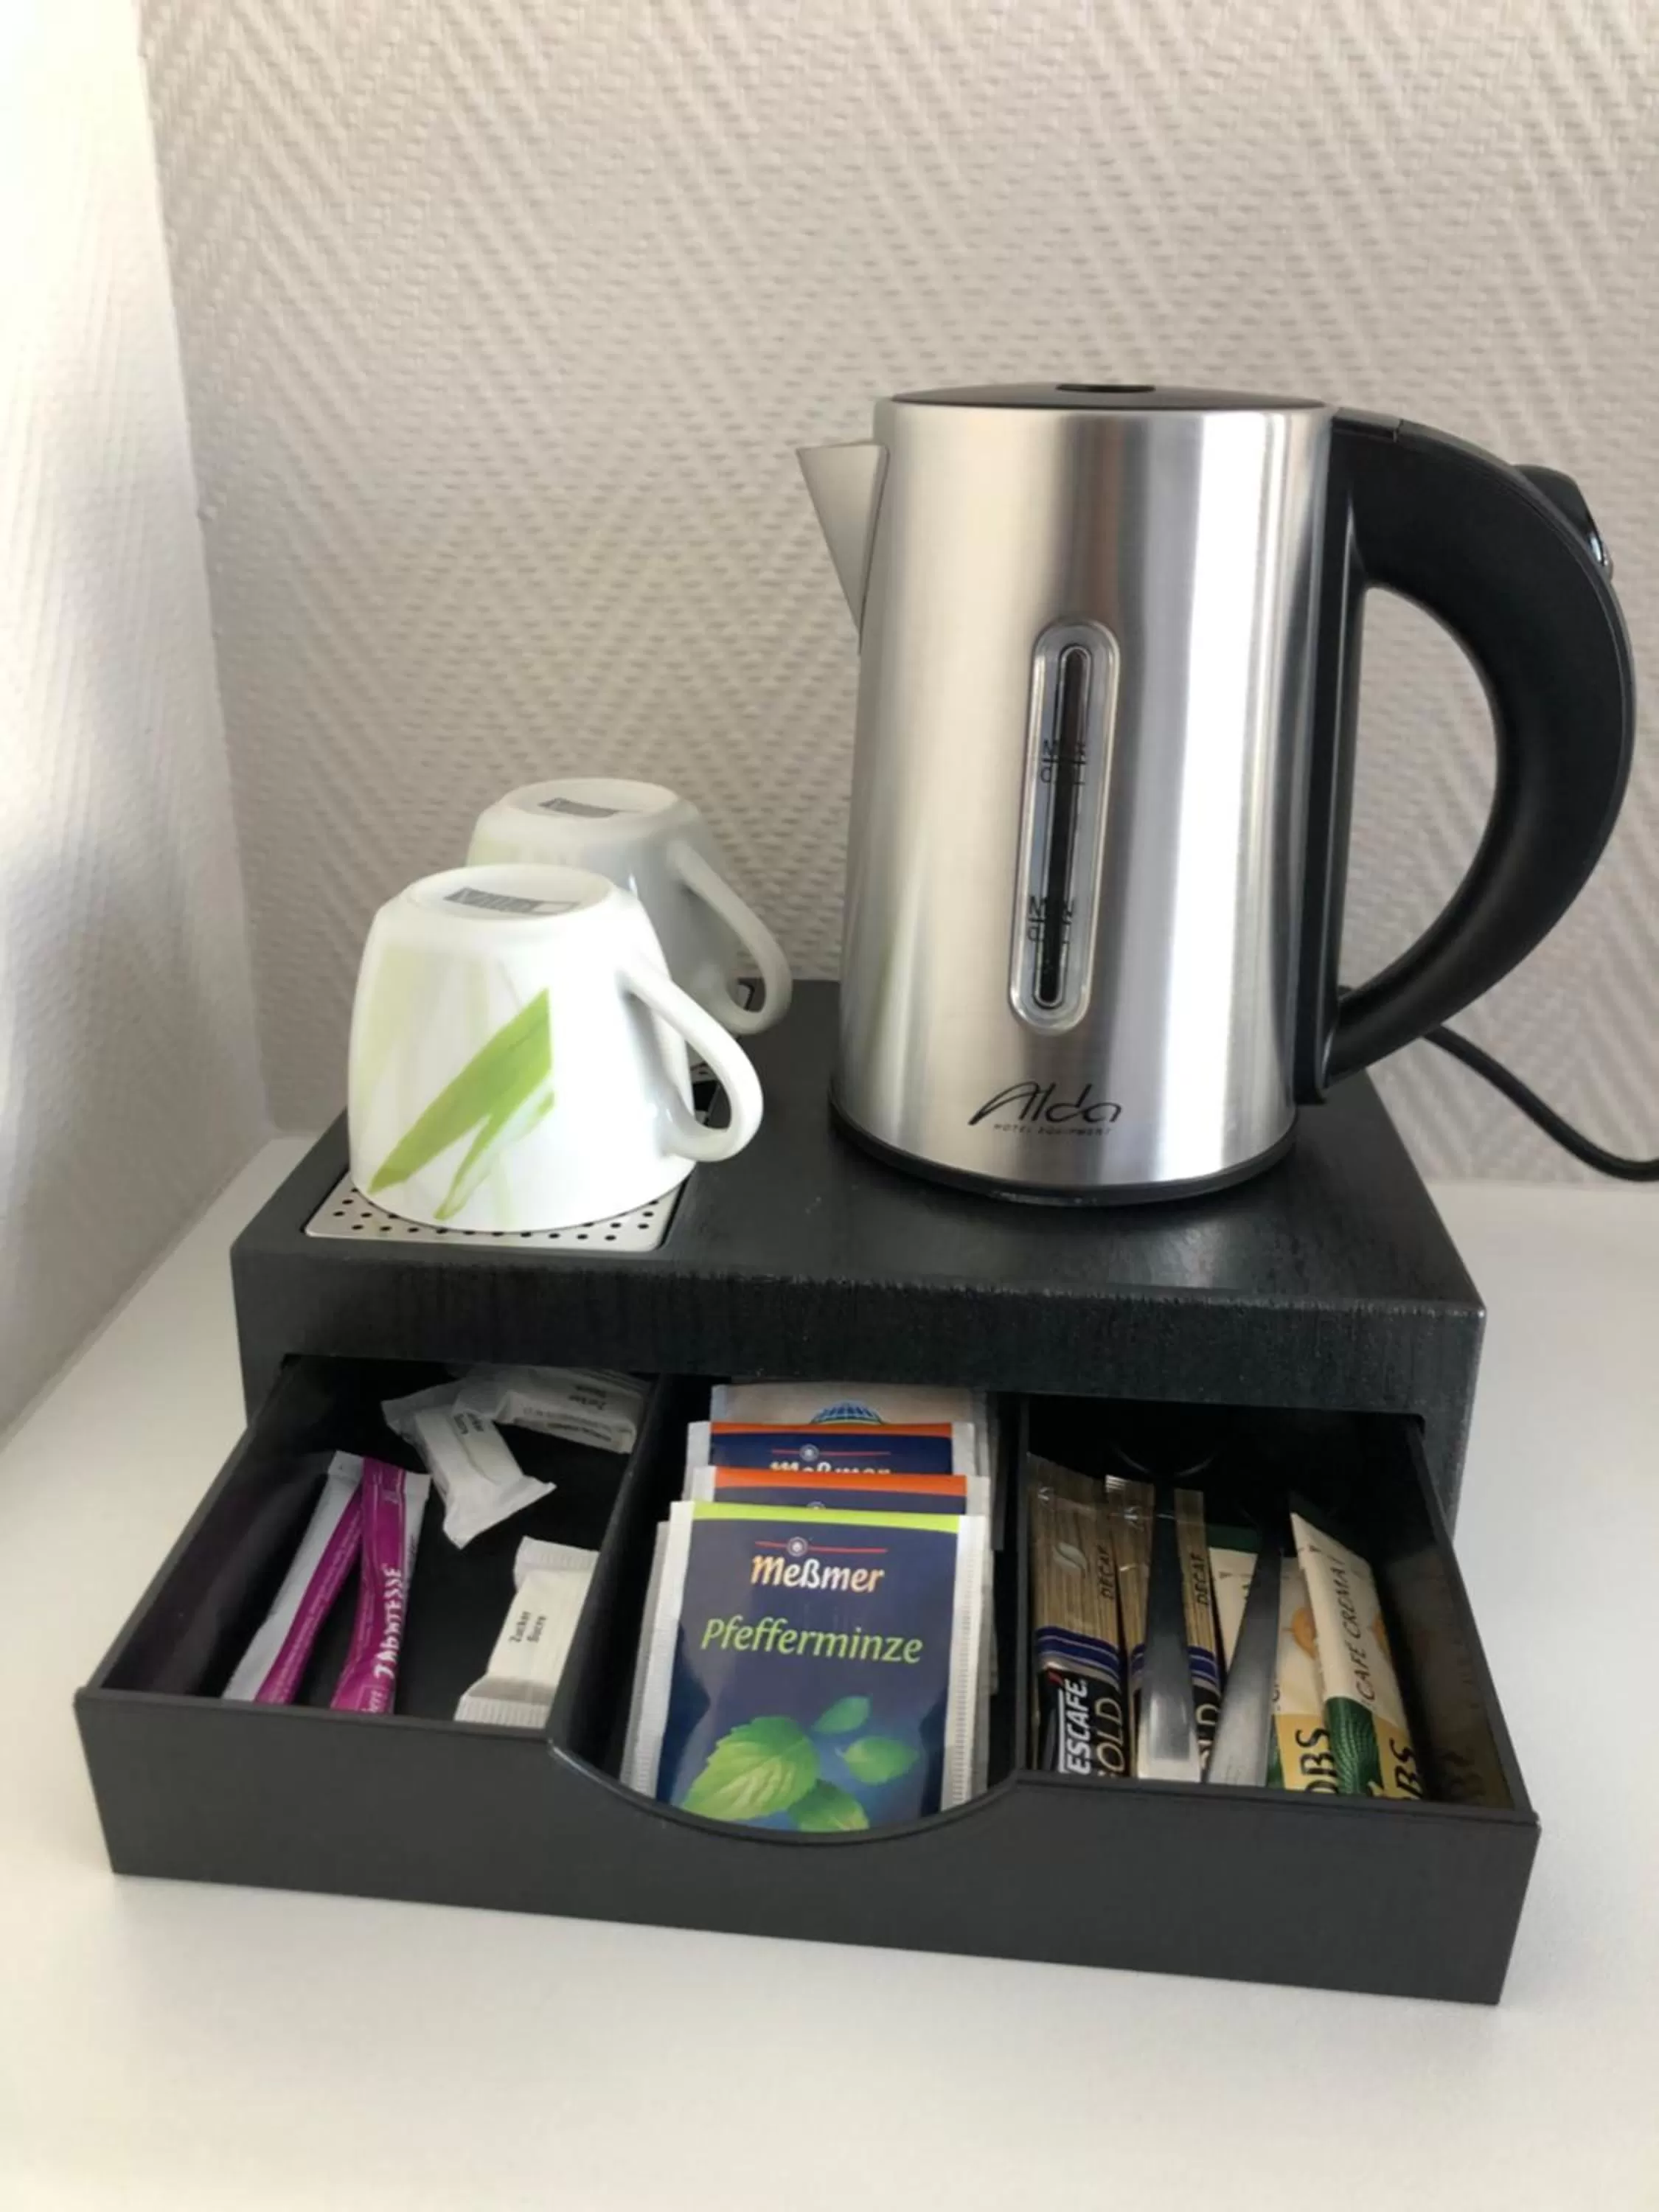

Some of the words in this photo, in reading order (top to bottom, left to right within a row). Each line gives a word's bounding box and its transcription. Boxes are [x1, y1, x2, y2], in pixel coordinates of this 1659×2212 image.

[968, 1081, 1121, 1125] Alda
[751, 1554, 886, 1593] Meßmer
[700, 1614, 923, 1664] Pfefferminze
[1095, 1697, 1125, 1778] OLD
